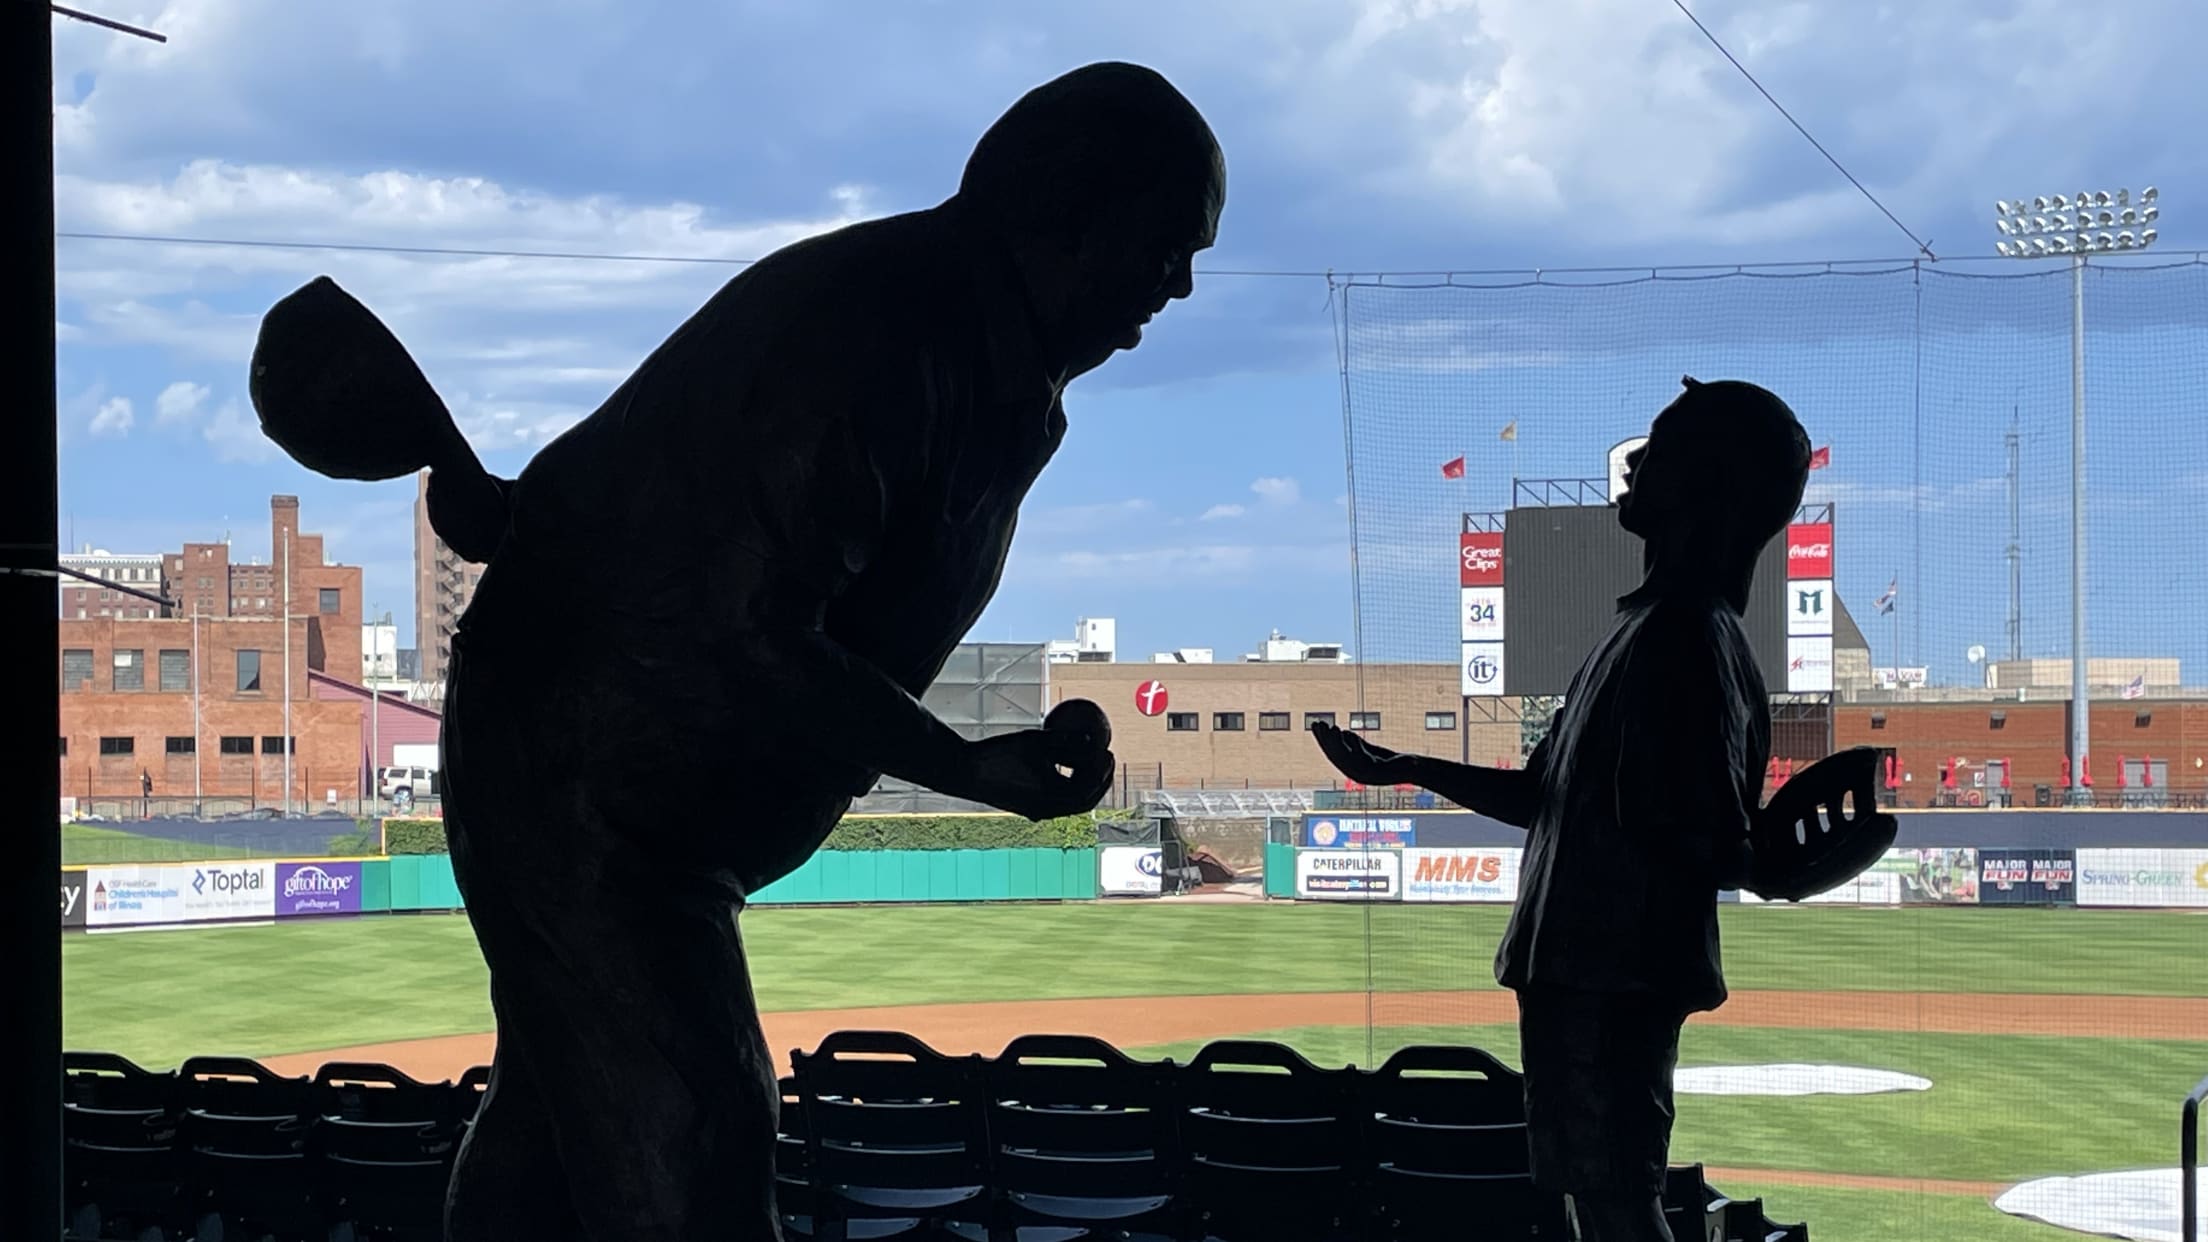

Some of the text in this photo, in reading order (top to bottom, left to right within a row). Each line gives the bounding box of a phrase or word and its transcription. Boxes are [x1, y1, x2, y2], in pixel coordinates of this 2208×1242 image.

[1462, 546, 1502, 559] Great
[1465, 557, 1498, 573] Clips
[1470, 605, 1494, 622] 34
[1313, 858, 1382, 870] CATERPILLAR
[1414, 856, 1502, 882] MMS
[1984, 860, 2027, 870] MAJOR
[2032, 860, 2073, 870] MAJOR
[207, 868, 265, 894] Toptal
[1986, 871, 2025, 879] FUN
[2035, 871, 2070, 879] FUN
